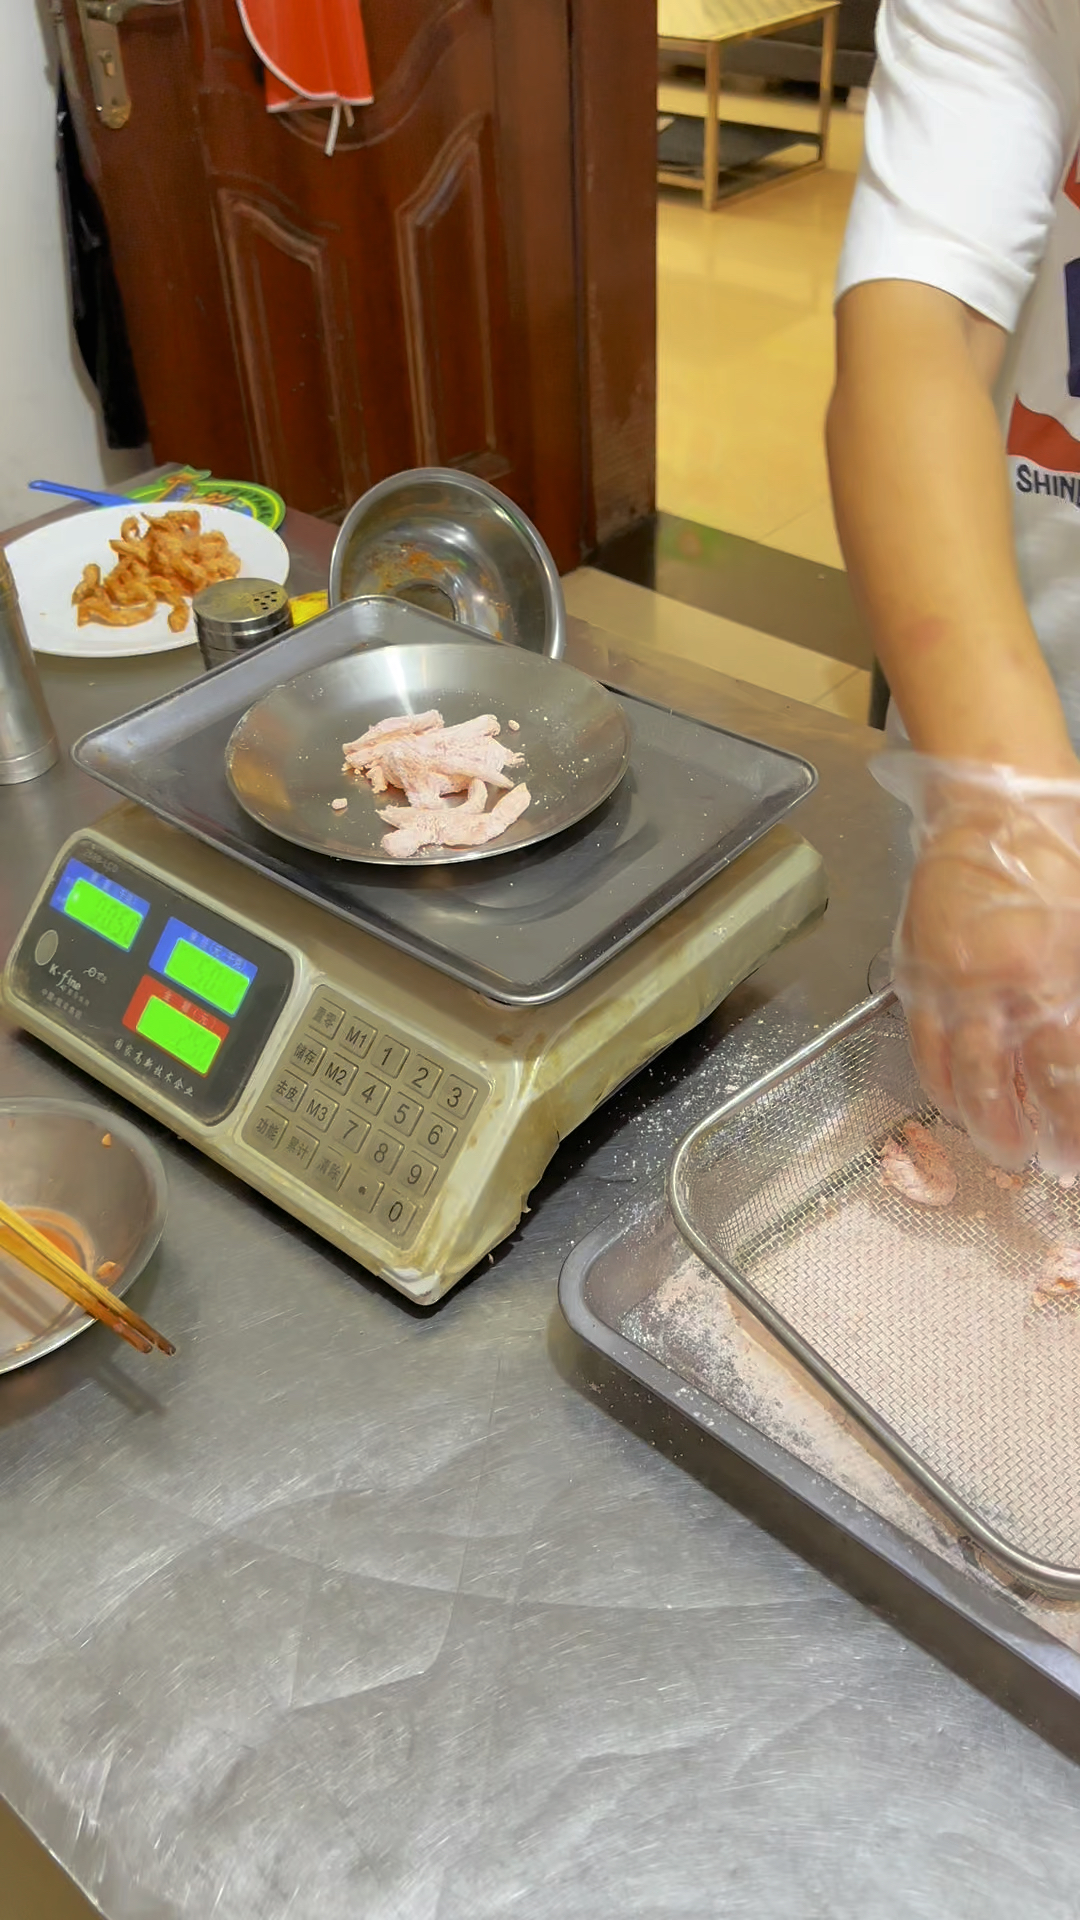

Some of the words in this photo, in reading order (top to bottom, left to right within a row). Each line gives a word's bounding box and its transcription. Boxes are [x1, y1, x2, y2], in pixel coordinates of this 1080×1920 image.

[1016, 464, 1080, 508] SHIN
[345, 1025, 368, 1049] M1
[381, 1046, 393, 1066] 1
[324, 1062, 348, 1086] M2
[412, 1067, 429, 1089] 2
[274, 1079, 298, 1103] 去皮
[361, 1084, 377, 1104] 4
[446, 1086, 463, 1109] 3
[305, 1098, 329, 1122] M3
[393, 1103, 411, 1125] 5
[256, 1117, 279, 1142] 功能
[342, 1119, 359, 1140] 7
[427, 1124, 443, 1146] 6
[373, 1142, 389, 1164] 8
[406, 1164, 422, 1185] 9
[388, 1201, 404, 1223] 0
